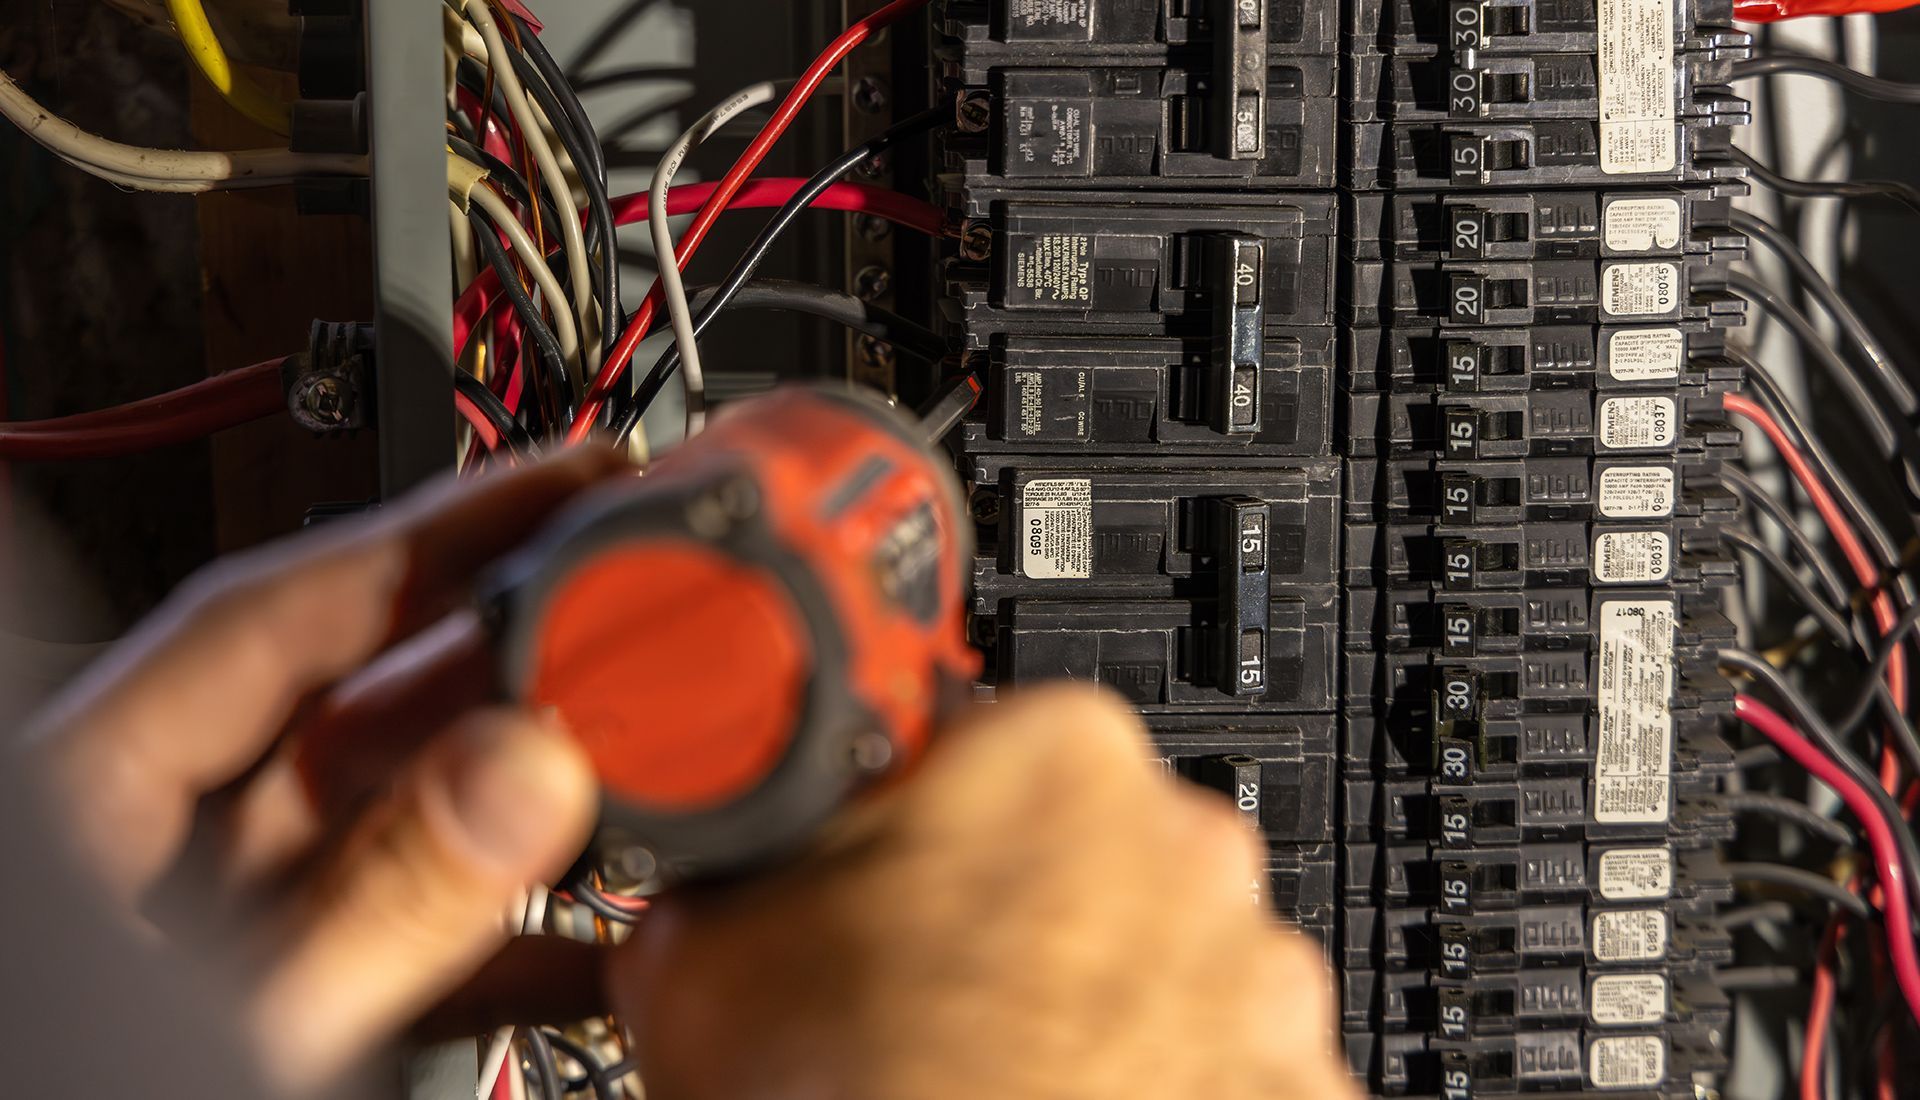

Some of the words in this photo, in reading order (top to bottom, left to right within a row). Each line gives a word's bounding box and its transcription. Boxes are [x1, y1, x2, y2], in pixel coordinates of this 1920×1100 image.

[1456, 8, 1478, 46] 30
[1453, 74, 1476, 112] 30
[1237, 111, 1253, 134] 50
[1455, 147, 1478, 177] 15
[1456, 219, 1478, 249] 20
[1017, 253, 1025, 287] SIEMENS
[1070, 237, 1079, 275] Interrupting
[1078, 262, 1089, 284] Type
[1237, 263, 1254, 285] 40
[1069, 277, 1079, 299] Rating
[1079, 287, 1089, 300] QP
[1455, 286, 1478, 315] 20
[1611, 268, 1620, 313] SIEMENS
[1452, 355, 1475, 384] 15
[1233, 384, 1251, 406] 40
[1450, 422, 1473, 451] 15
[1606, 401, 1615, 445] SIEMENS
[1654, 405, 1666, 441] 08037
[1446, 488, 1468, 517] 15
[1031, 519, 1043, 556] 08095
[1242, 524, 1261, 553] 15
[1447, 554, 1470, 582] 15
[1603, 535, 1611, 578] SIEMENS
[1651, 538, 1662, 574] 08037
[1616, 606, 1645, 617] 08017
[1447, 617, 1470, 646] 15
[1241, 655, 1261, 684] 15
[1447, 680, 1470, 709] 30
[1443, 747, 1466, 776] 30
[1238, 783, 1258, 810] 20
[1444, 814, 1466, 843] 15
[1444, 879, 1466, 909] 15
[1598, 915, 1607, 957] SIEMENS
[1443, 943, 1466, 973] 15
[1442, 1006, 1465, 1037] 15
[1445, 1070, 1468, 1100] 15
